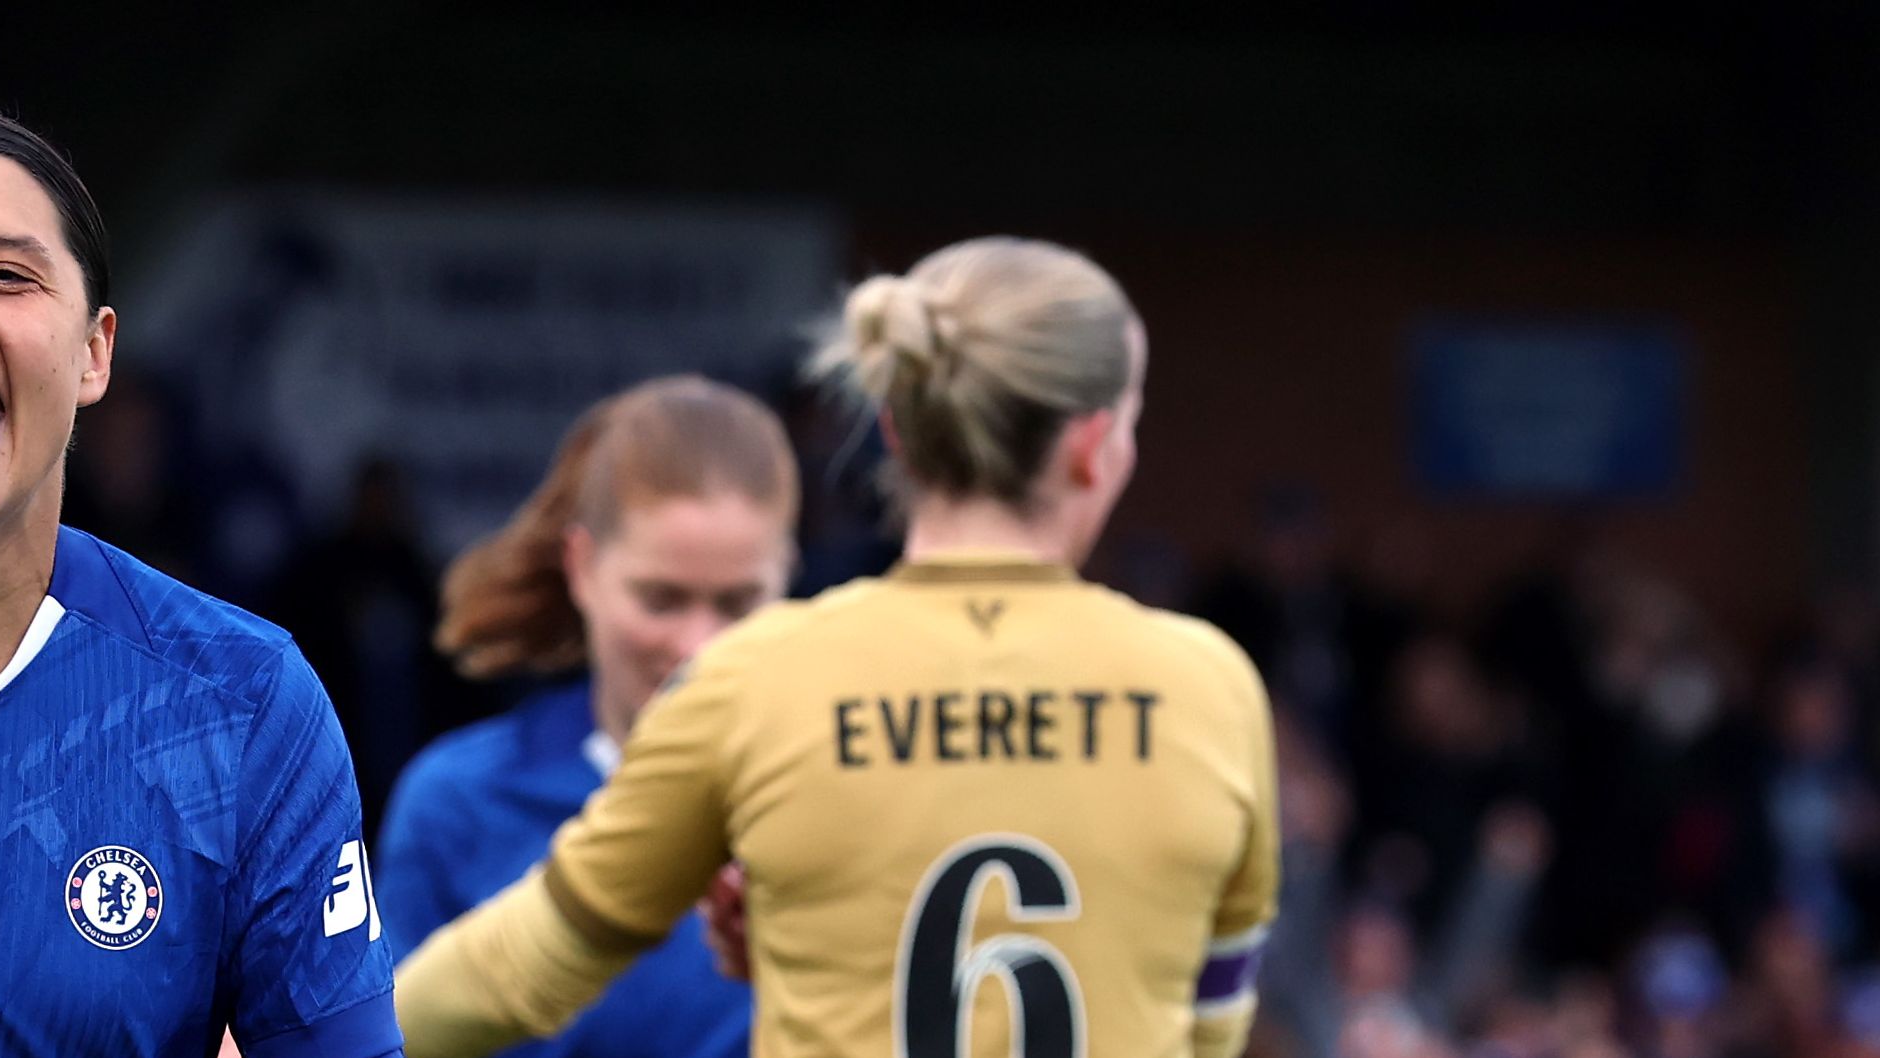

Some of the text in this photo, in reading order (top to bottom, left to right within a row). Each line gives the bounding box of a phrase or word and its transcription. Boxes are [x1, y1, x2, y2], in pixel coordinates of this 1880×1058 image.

[834, 688, 1162, 769] EVERETT
[86, 851, 146, 875] CHELSEA
[82, 922, 143, 943] FOOTBALL CLUB
